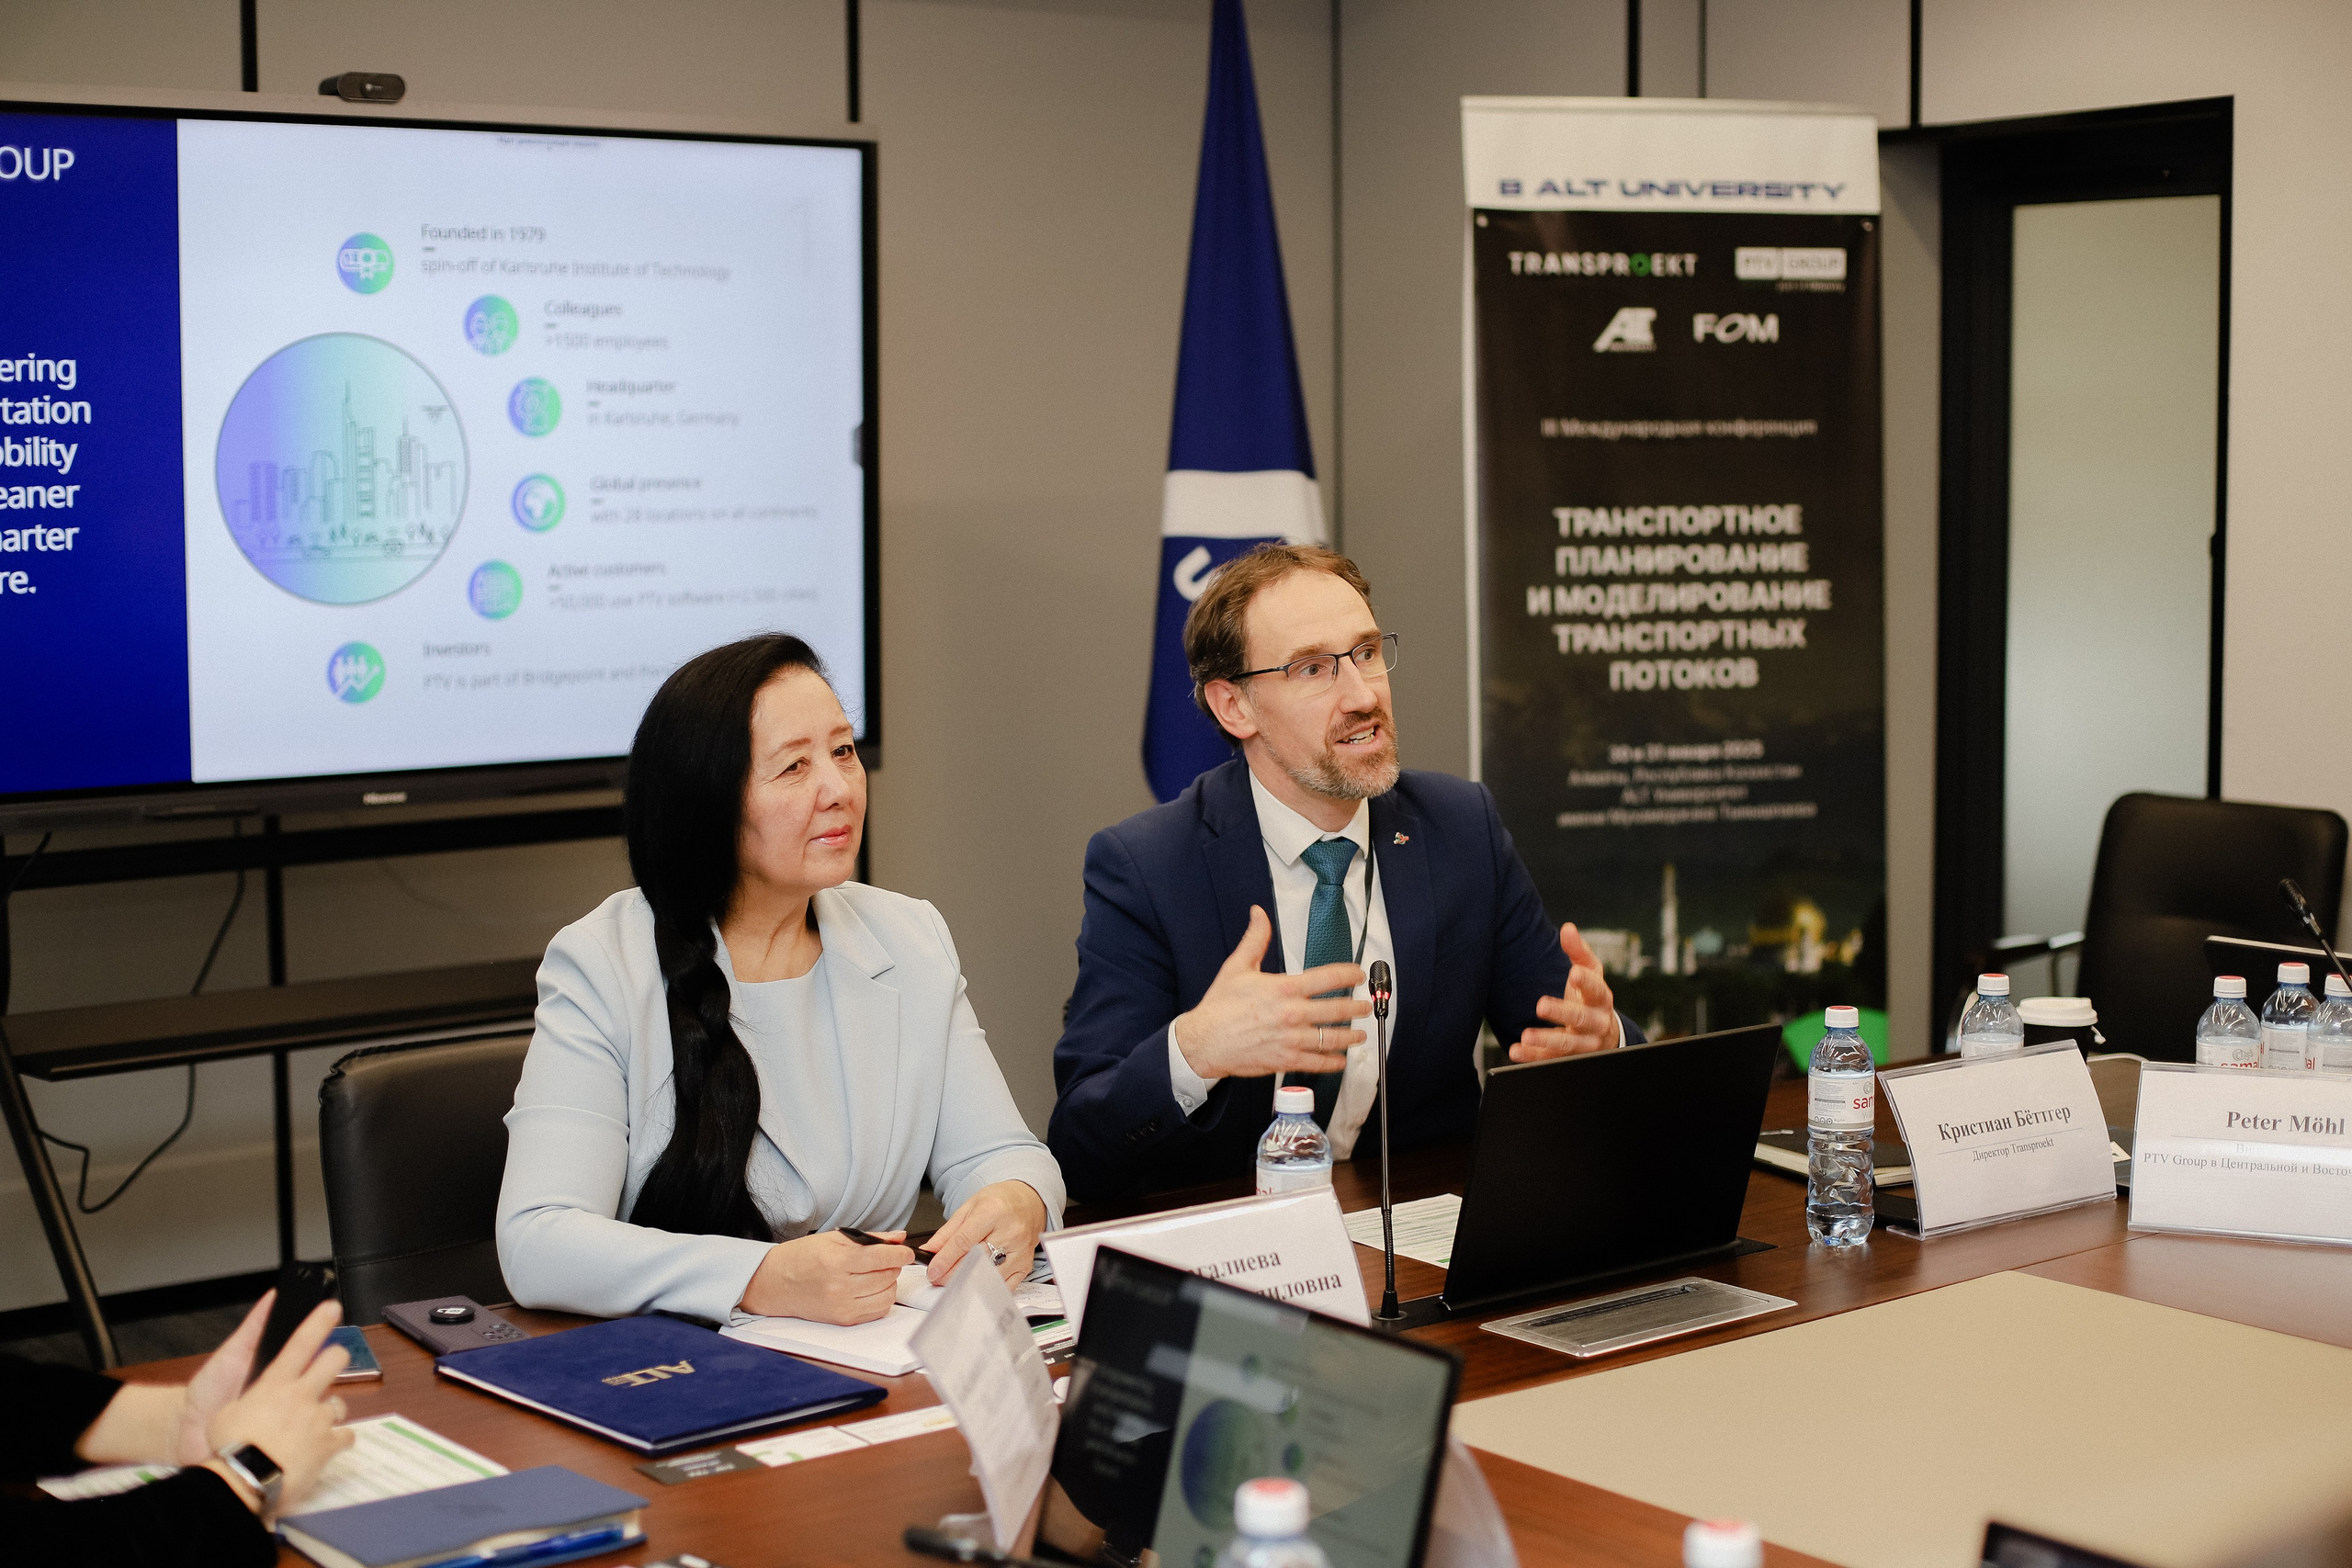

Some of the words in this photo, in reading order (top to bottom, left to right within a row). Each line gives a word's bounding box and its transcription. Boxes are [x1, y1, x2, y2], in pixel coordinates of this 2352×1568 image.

[1537, 179, 1609, 197] ALT
[1620, 180, 1847, 199] UNIVERSITY
[421, 222, 488, 242] Founded
[491, 223, 505, 242] in
[1508, 251, 1699, 277] TRANSPROEKT
[1691, 312, 1780, 344] FOM
[1553, 504, 1804, 537] ТРАНСПОРТНОЕ
[0, 524, 81, 552] arter
[1555, 542, 1810, 577] ПЛАНИРОВАНИЕ
[1526, 586, 1553, 616] И
[1554, 580, 1833, 620] МОДЕЛИРОВАНИЕ
[1552, 619, 1807, 654] ТРАНСПОРТНЫХ
[1609, 658, 1759, 692] ПОТОКОВ
[1937, 1115, 2013, 1144] Кристиан
[2013, 1106, 2072, 1128] Бёттгер
[2225, 1111, 2282, 1132] Peter
[2289, 1114, 2346, 1135] Möhl
[1973, 1146, 2010, 1162] Директор
[2010, 1137, 2054, 1155] Transproekt
[2143, 1152, 2169, 1165] PTV
[2172, 1154, 2208, 1169] Group
[2221, 1156, 2298, 1173] Центральной
[1188, 1251, 1282, 1280] галиева
